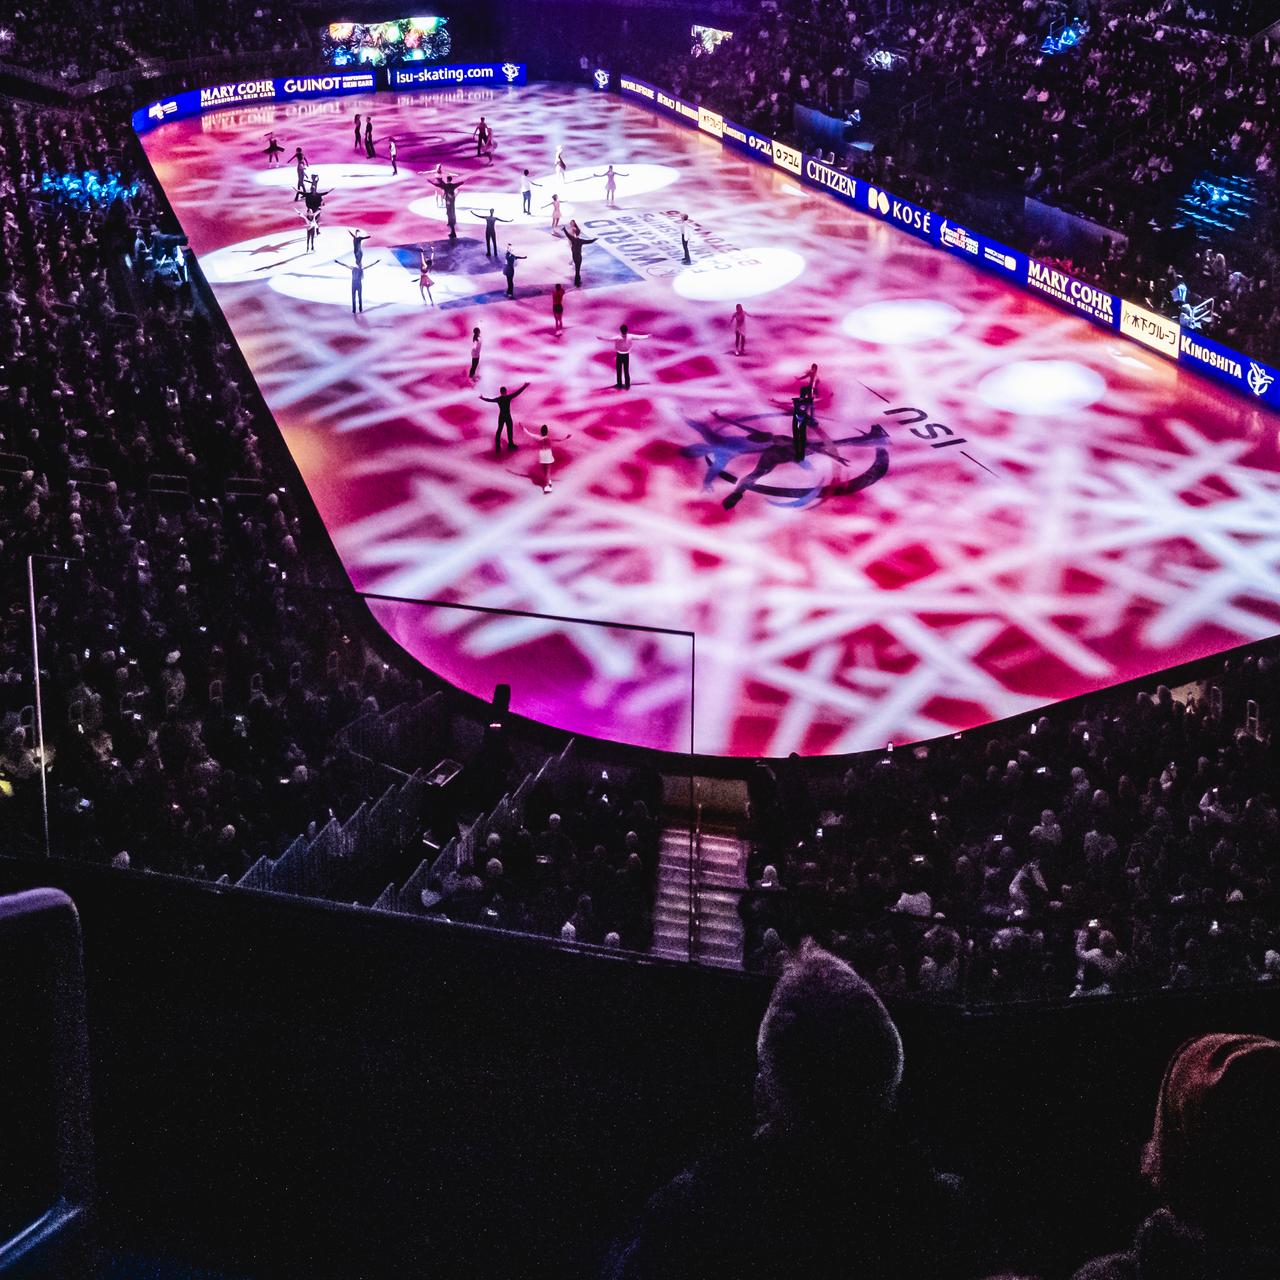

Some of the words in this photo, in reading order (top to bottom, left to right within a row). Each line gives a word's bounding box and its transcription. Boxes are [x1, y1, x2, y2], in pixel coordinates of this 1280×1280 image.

[201, 85, 236, 102] MARY
[238, 81, 275, 95] COHR
[284, 77, 341, 93] GUINOT
[397, 66, 494, 84] isu-skating.com
[806, 160, 857, 198] CITIZEN
[893, 201, 932, 234] KOSÉ
[1027, 277, 1076, 307] PROFESSIONAL
[1076, 301, 1094, 314] SKIN
[1094, 309, 1114, 324] CARE
[1028, 260, 1070, 292] MARY
[1071, 281, 1114, 315] COHR
